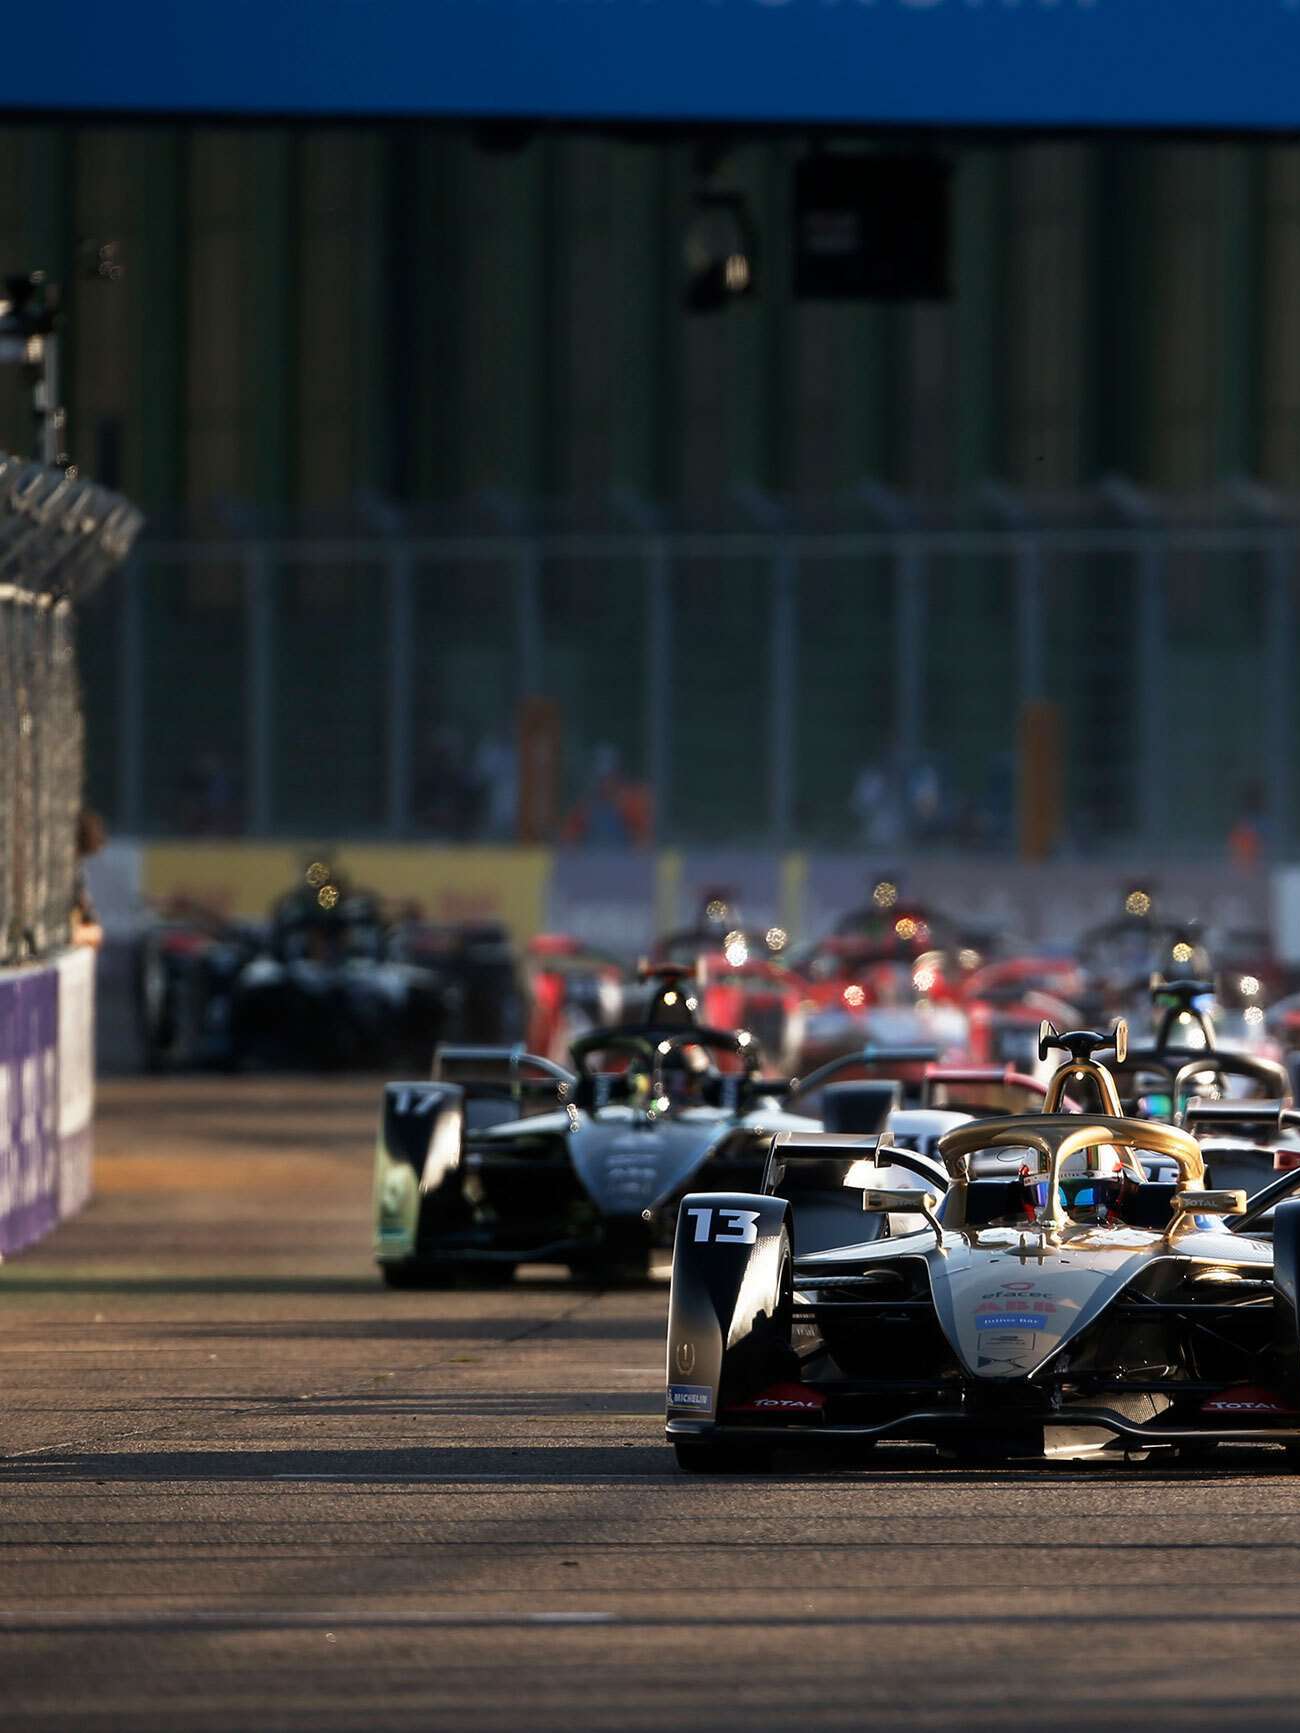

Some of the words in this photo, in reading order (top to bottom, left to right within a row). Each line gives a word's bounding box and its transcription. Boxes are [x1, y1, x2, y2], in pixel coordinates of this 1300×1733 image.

[392, 1089, 446, 1114] 17
[1183, 1199, 1218, 1208] TOTAL
[687, 1208, 760, 1244] 13
[674, 1392, 708, 1405] MICHELIN
[750, 1398, 818, 1409] TOTAL
